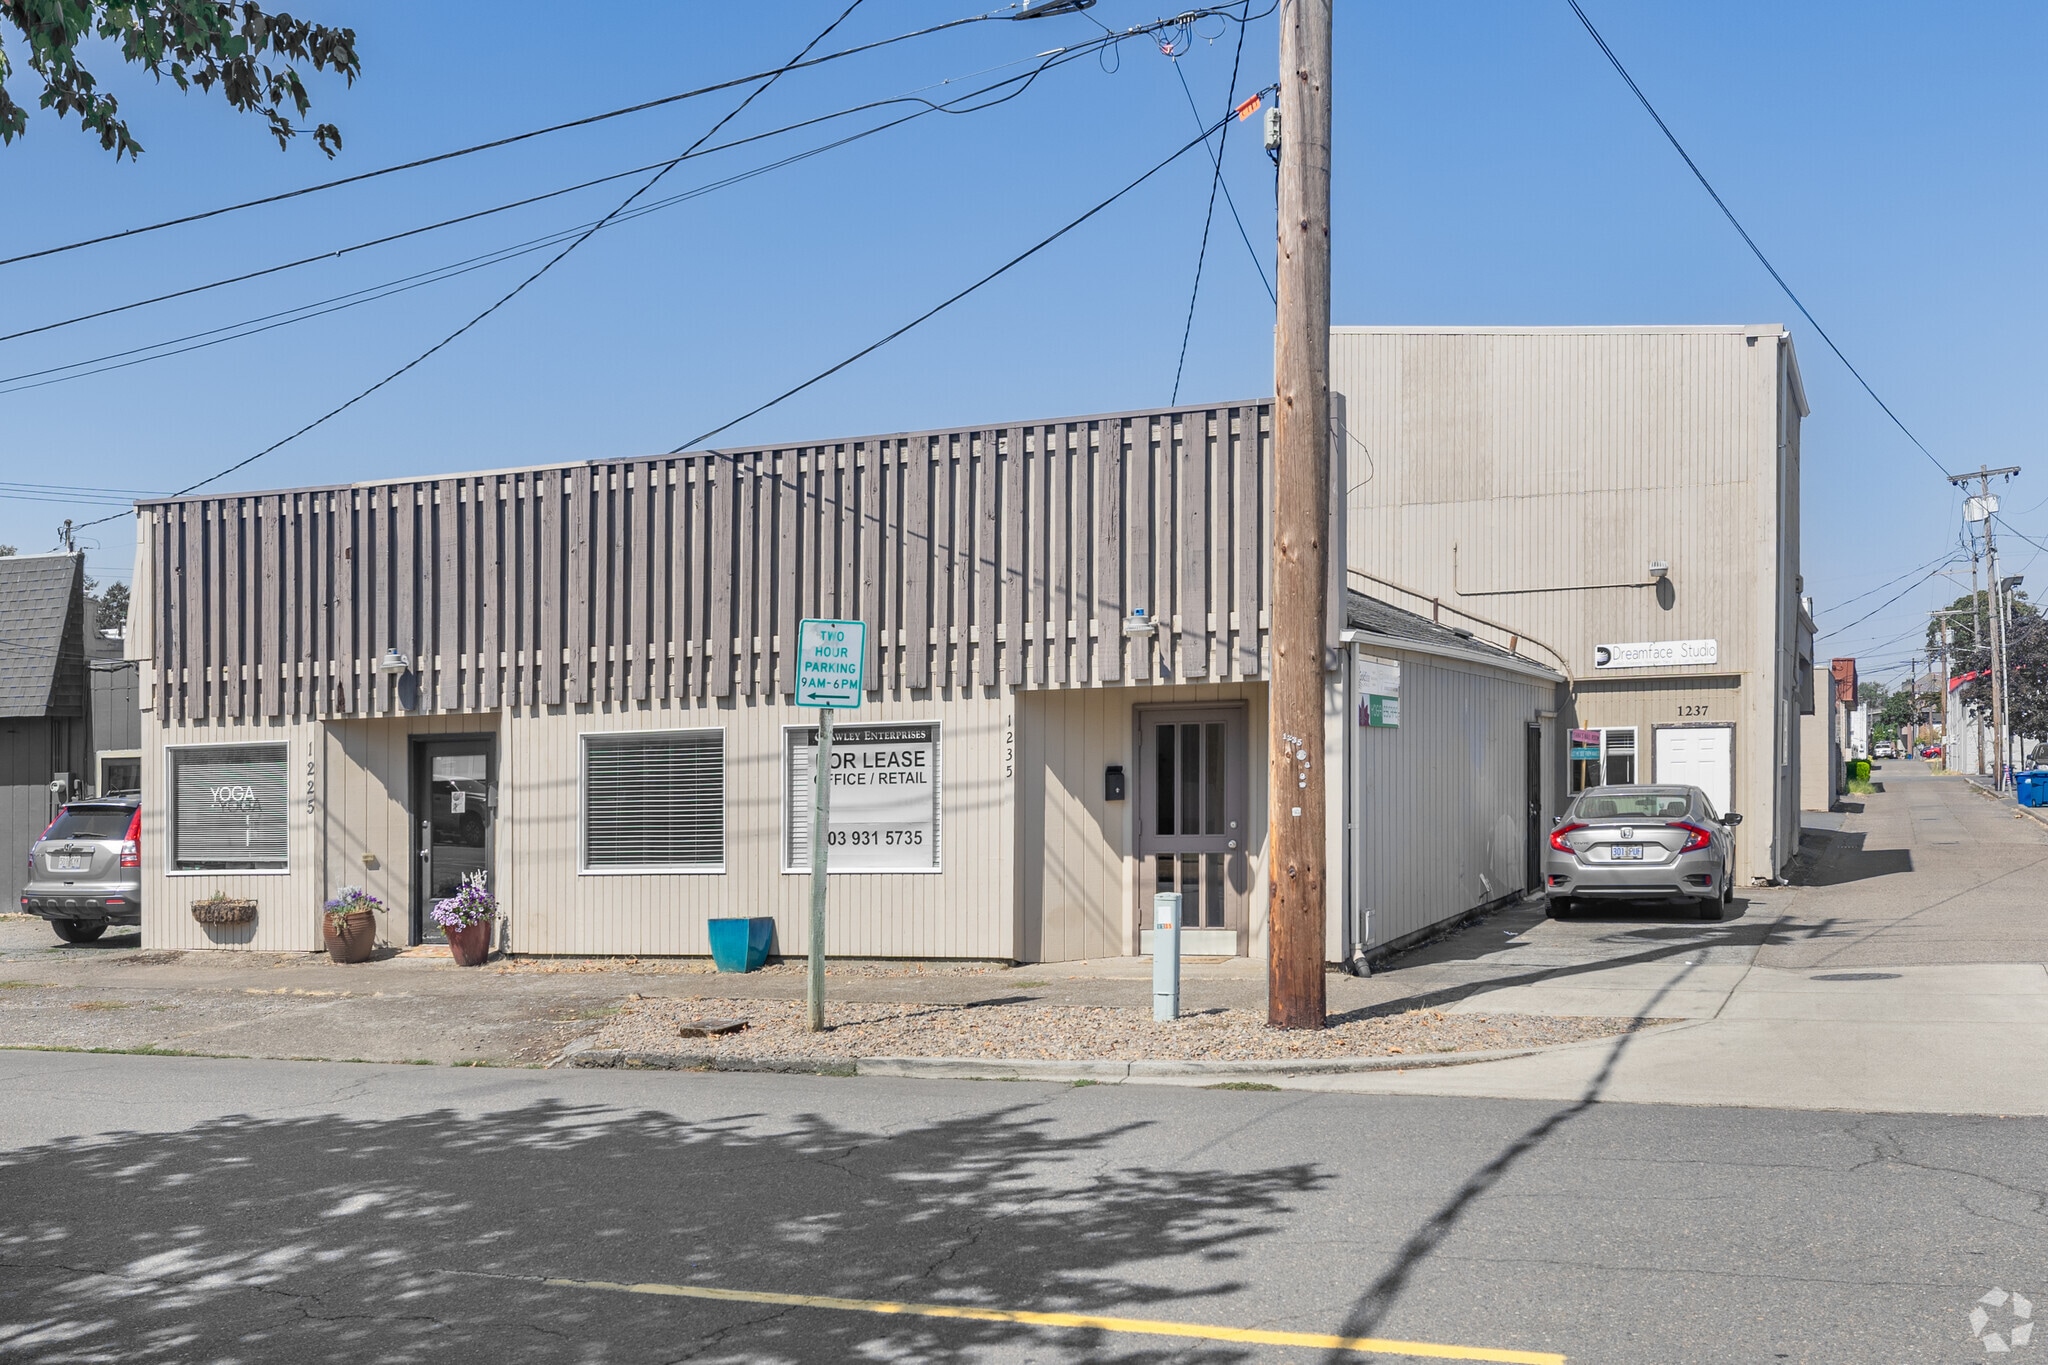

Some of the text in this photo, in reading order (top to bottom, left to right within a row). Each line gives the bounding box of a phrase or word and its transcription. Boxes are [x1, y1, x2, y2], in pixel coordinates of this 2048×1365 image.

[820, 630, 845, 642] TWO
[814, 646, 848, 658] HOUR
[1612, 643, 1673, 661] Dreamface
[1680, 641, 1716, 658] Studio
[804, 661, 856, 674] PARKING
[1677, 705, 1709, 716] 1237
[814, 732, 861, 742] WLEY
[1004, 714, 1014, 778] 1235
[815, 750, 926, 769] OR LEASE
[306, 741, 315, 815] 1225
[813, 773, 866, 785] FICE
[878, 771, 928, 785] RETAIL
[210, 785, 256, 802] YOGA
[828, 830, 923, 846] 03 931 5735
